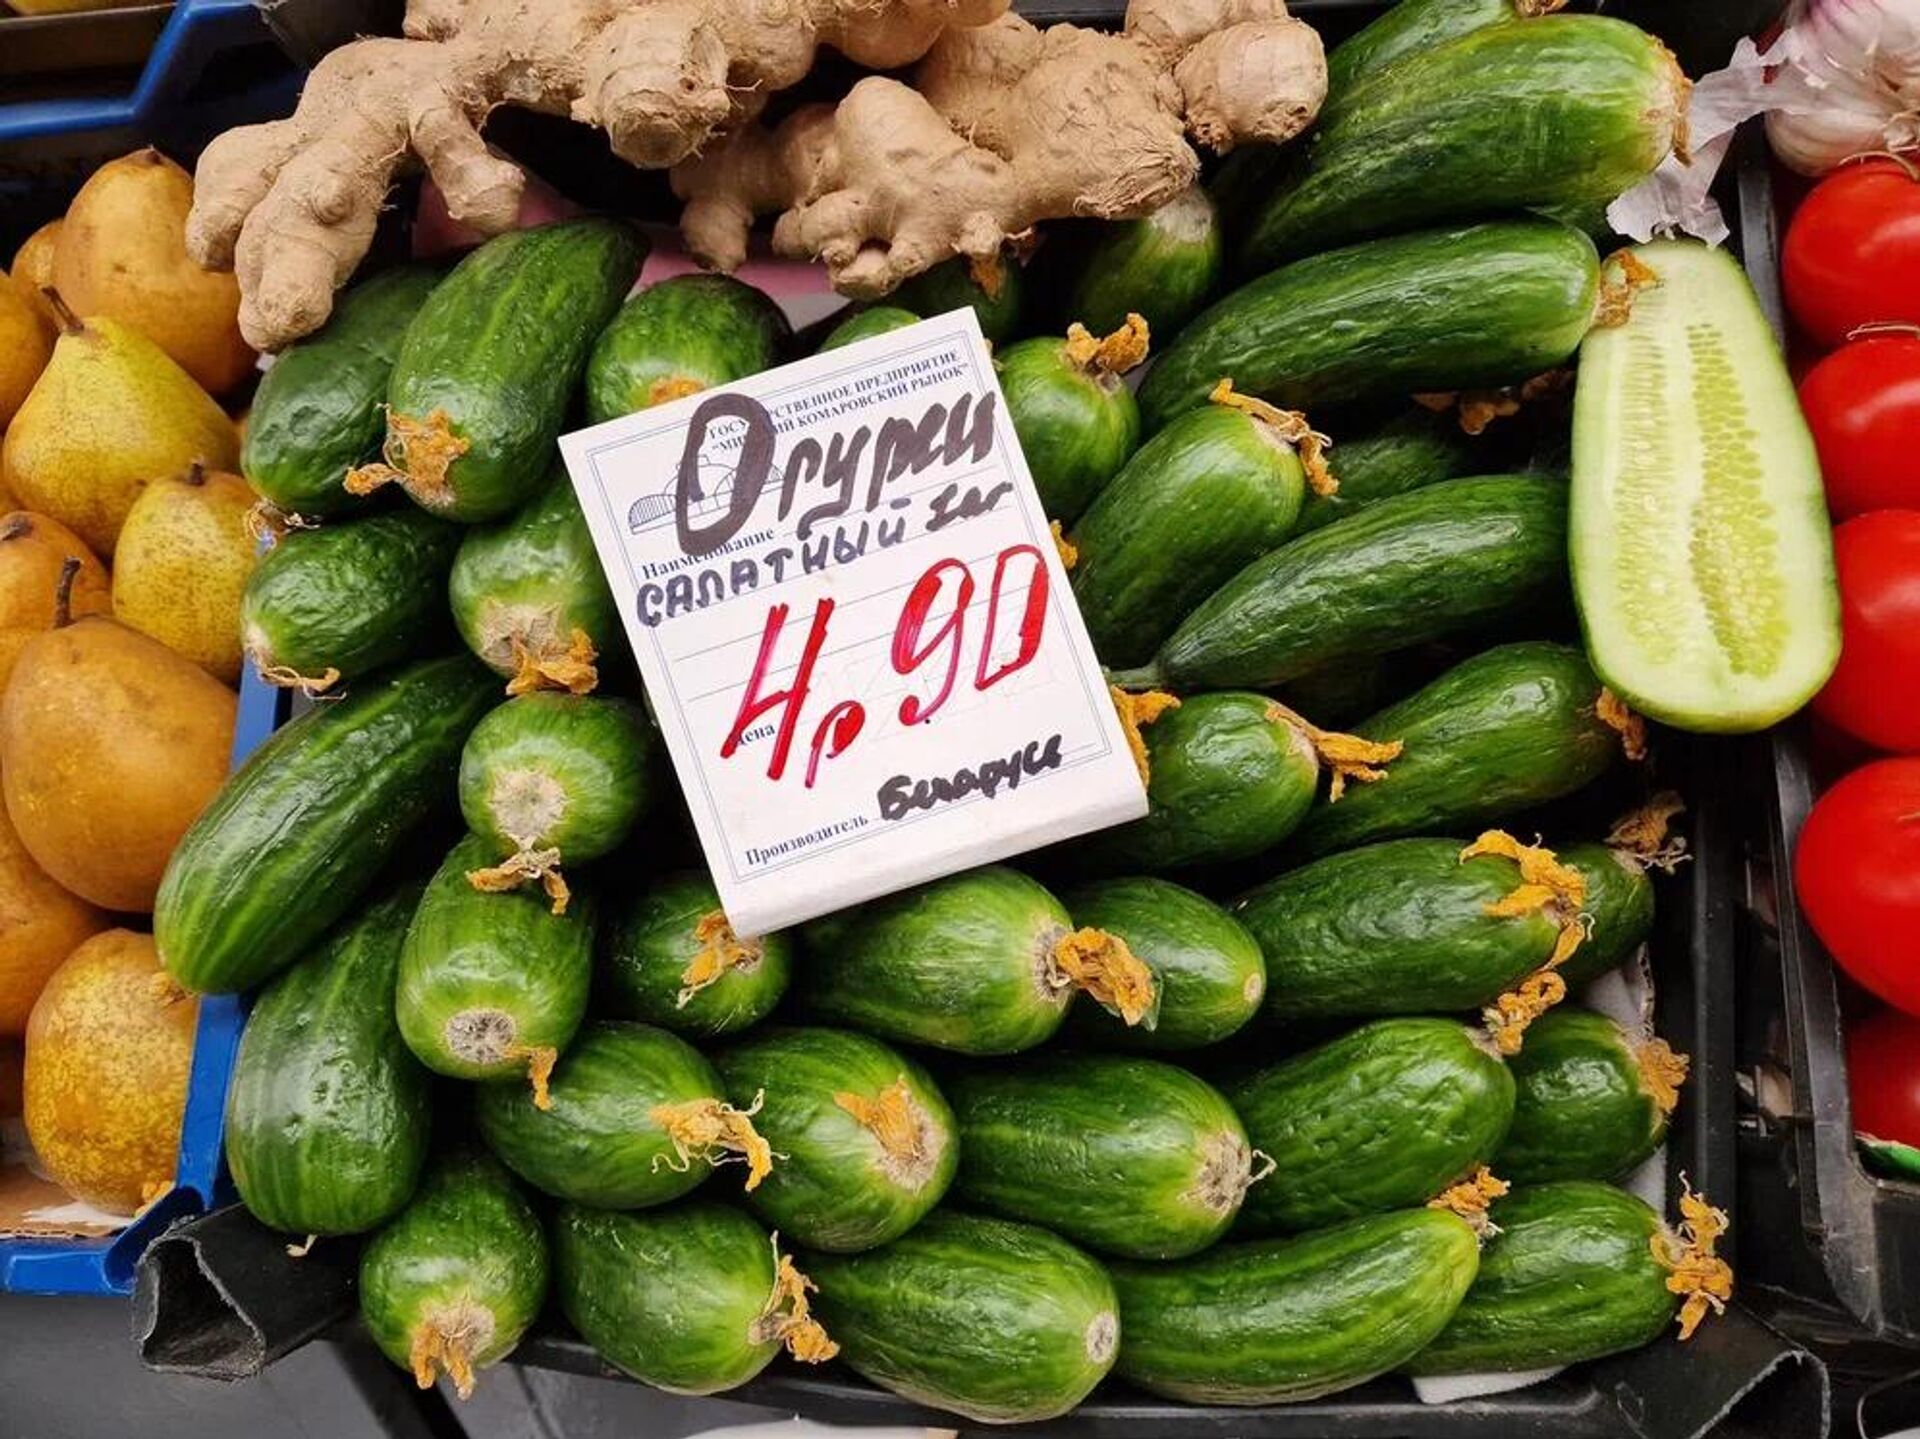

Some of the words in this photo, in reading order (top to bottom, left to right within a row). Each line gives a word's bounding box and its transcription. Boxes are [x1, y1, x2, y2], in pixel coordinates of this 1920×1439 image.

[709, 385, 852, 439] ГОСУСТВЕННОЕ
[854, 350, 959, 393] ПРЕДПРИЯТИЕ
[797, 383, 908, 427] КОМАРОВСКИЙ
[642, 528, 774, 579] Наименование
[736, 724, 776, 746] ена
[745, 814, 868, 866] Производитель
[877, 734, 1063, 821] Беларусь
